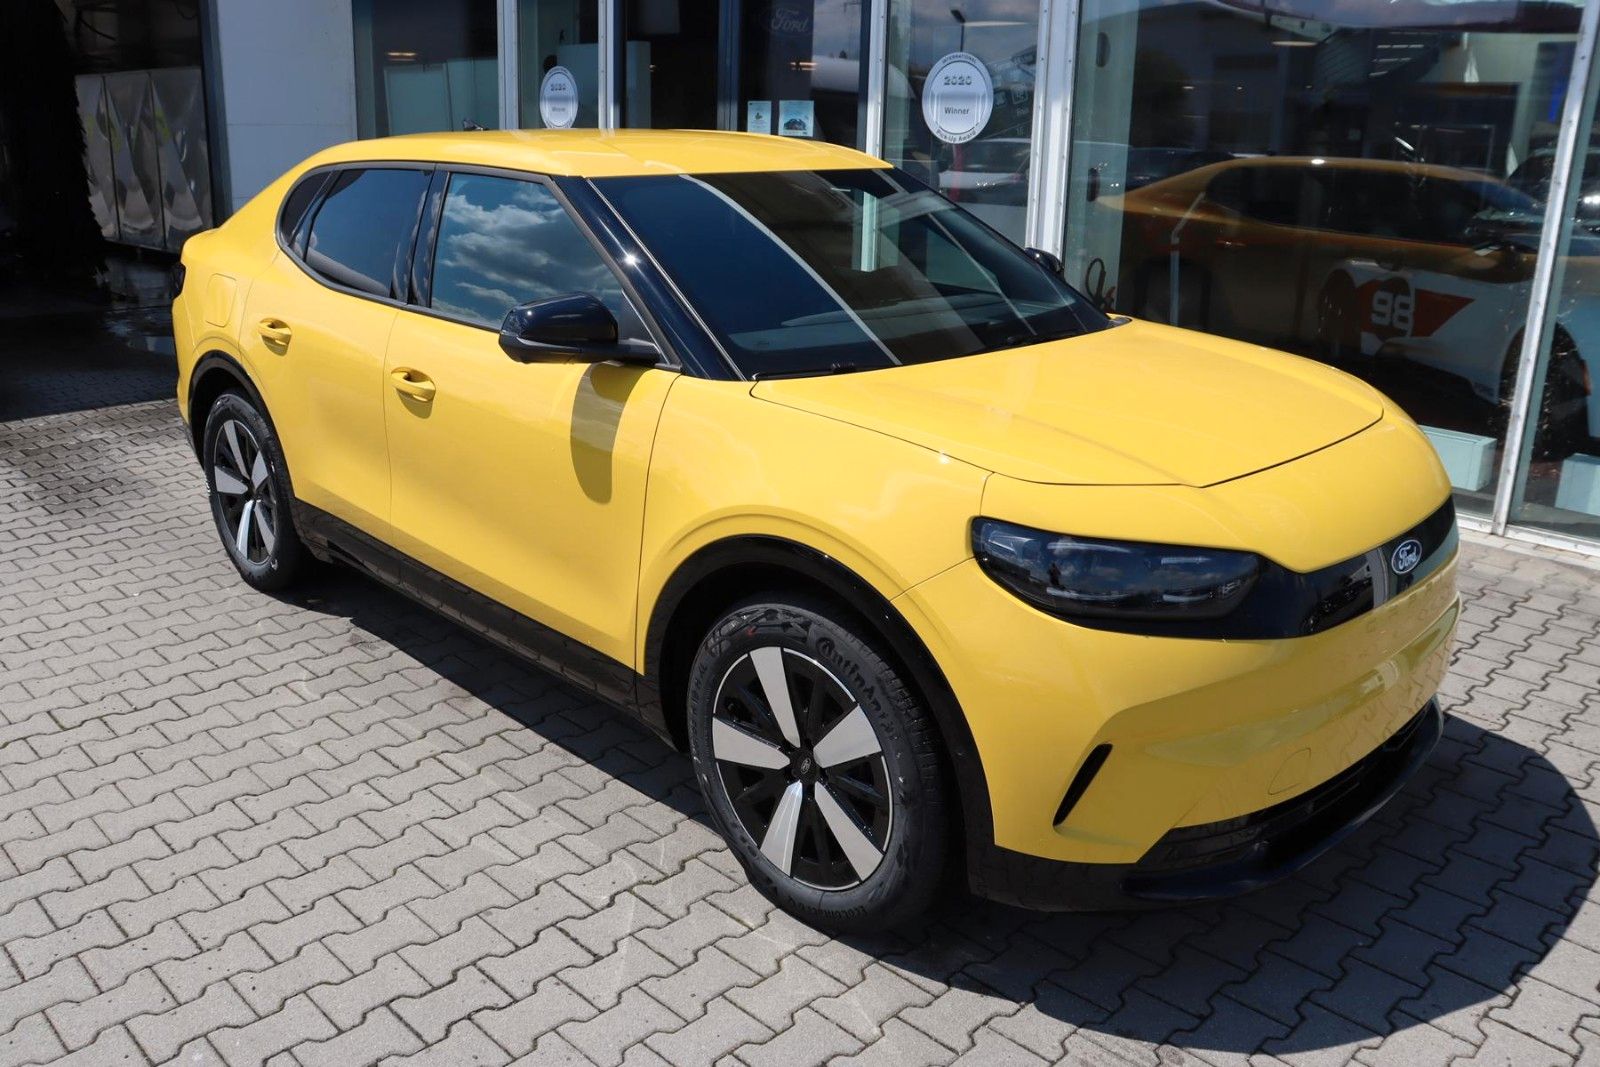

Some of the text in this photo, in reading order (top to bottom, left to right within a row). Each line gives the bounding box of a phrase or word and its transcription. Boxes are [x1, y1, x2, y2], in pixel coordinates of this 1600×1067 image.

[943, 75, 972, 86] 2020
[944, 107, 970, 115] Winner
[1371, 289, 1414, 331] 98
[1398, 544, 1418, 571] Ford
